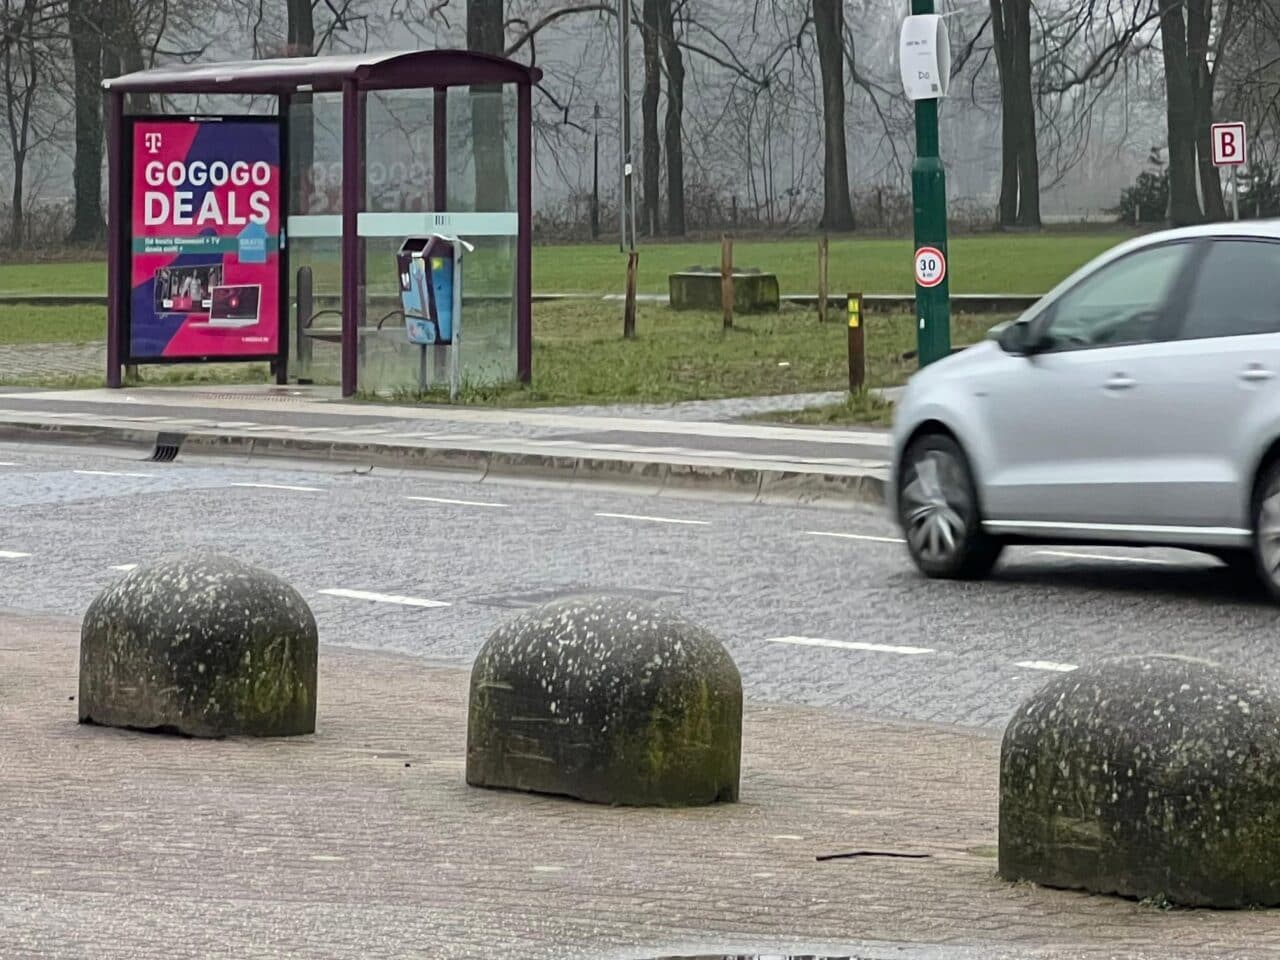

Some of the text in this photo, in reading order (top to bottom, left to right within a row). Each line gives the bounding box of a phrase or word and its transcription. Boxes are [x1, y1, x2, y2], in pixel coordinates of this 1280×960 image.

[145, 132, 162, 154] T
[1221, 131, 1236, 158] B
[145, 160, 271, 186] GOGOGO
[144, 190, 271, 226] DEALS
[920, 259, 936, 271] 30
